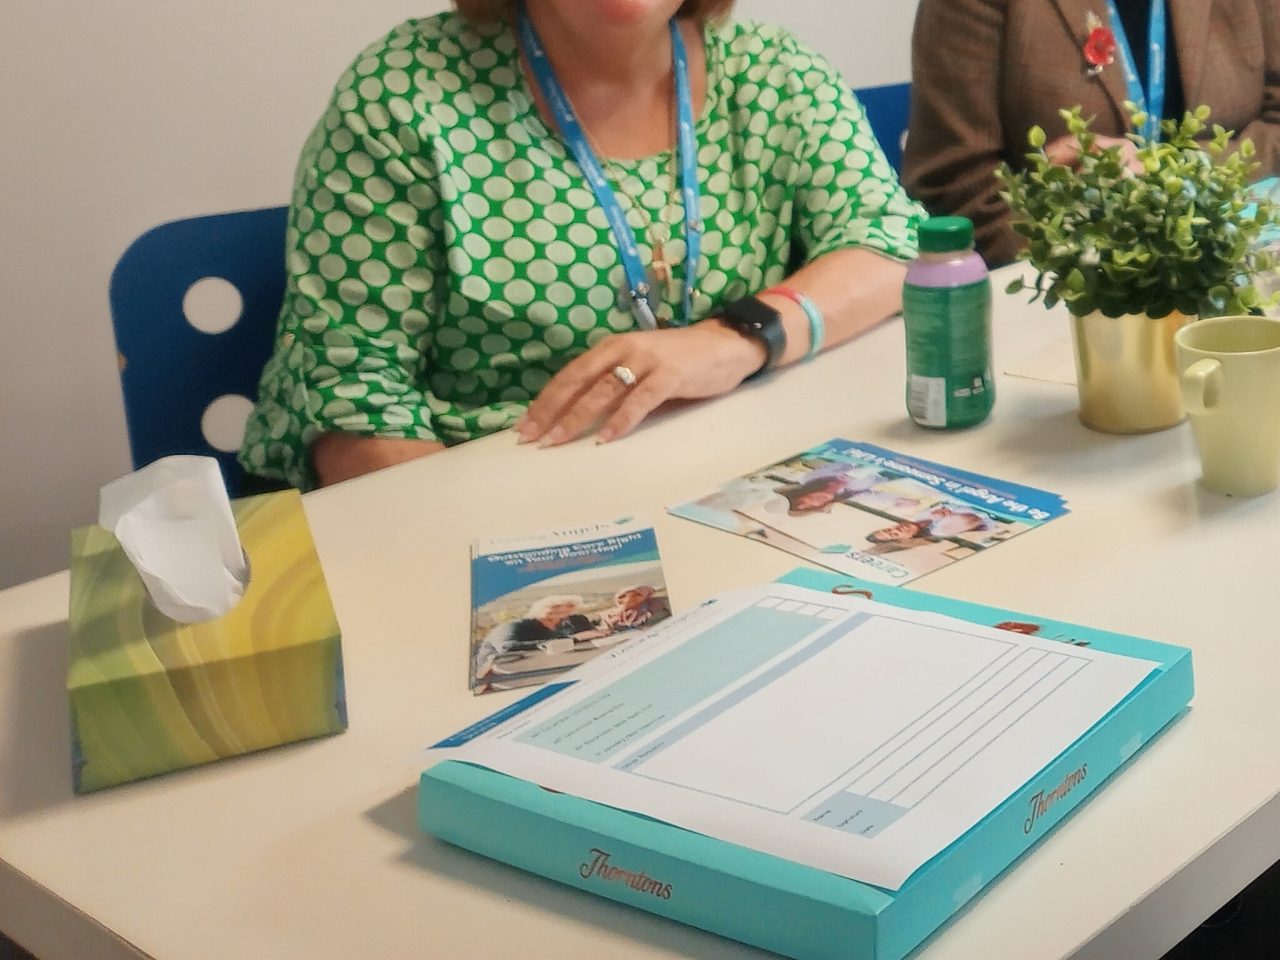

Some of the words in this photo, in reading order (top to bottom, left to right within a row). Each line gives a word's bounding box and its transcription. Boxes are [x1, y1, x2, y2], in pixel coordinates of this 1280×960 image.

[954, 486, 1005, 504] Angel
[1002, 499, 1029, 513] the
[1026, 508, 1050, 520] Be
[847, 551, 910, 579] Careers
[1023, 762, 1088, 835] Thorntons
[580, 848, 673, 900] Thorntons
